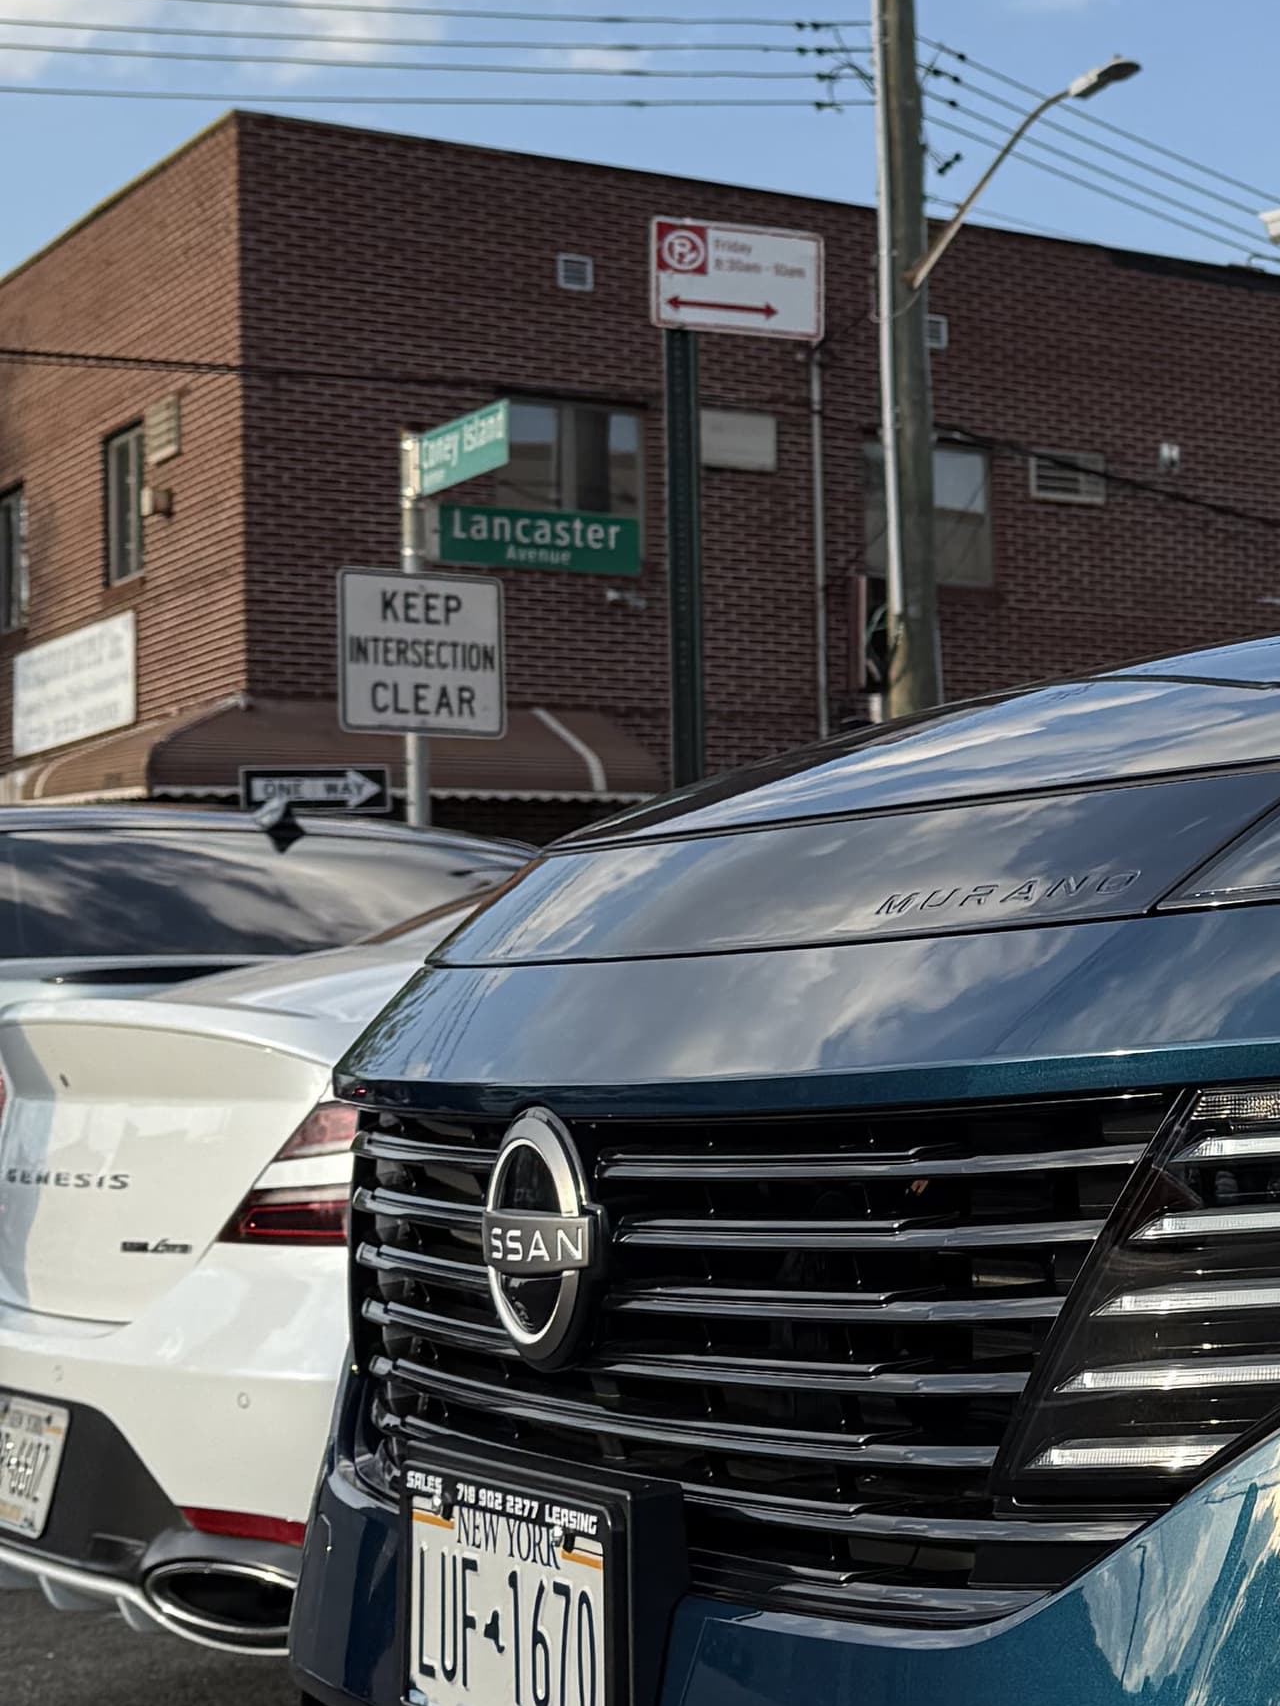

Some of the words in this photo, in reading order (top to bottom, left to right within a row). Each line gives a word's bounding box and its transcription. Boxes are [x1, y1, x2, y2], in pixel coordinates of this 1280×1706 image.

[452, 509, 622, 551] Lancaster
[506, 544, 572, 566] Avenue
[381, 591, 462, 626] KEEP
[350, 634, 496, 672] INTERSECTION
[371, 681, 477, 718] CLEAR
[263, 782, 303, 799] ONE
[323, 780, 365, 796] WAY
[872, 867, 1144, 918] MURANO
[6, 1168, 130, 1190] GENESIS
[406, 1470, 442, 1493] SALES
[456, 1483, 477, 1506] 718
[478, 1488, 503, 1510] 902
[505, 1494, 539, 1519] 2277
[545, 1503, 598, 1535] LEASING
[457, 1506, 499, 1554] NEW
[506, 1518, 561, 1570] YORK
[417, 1546, 479, 1691] LUF
